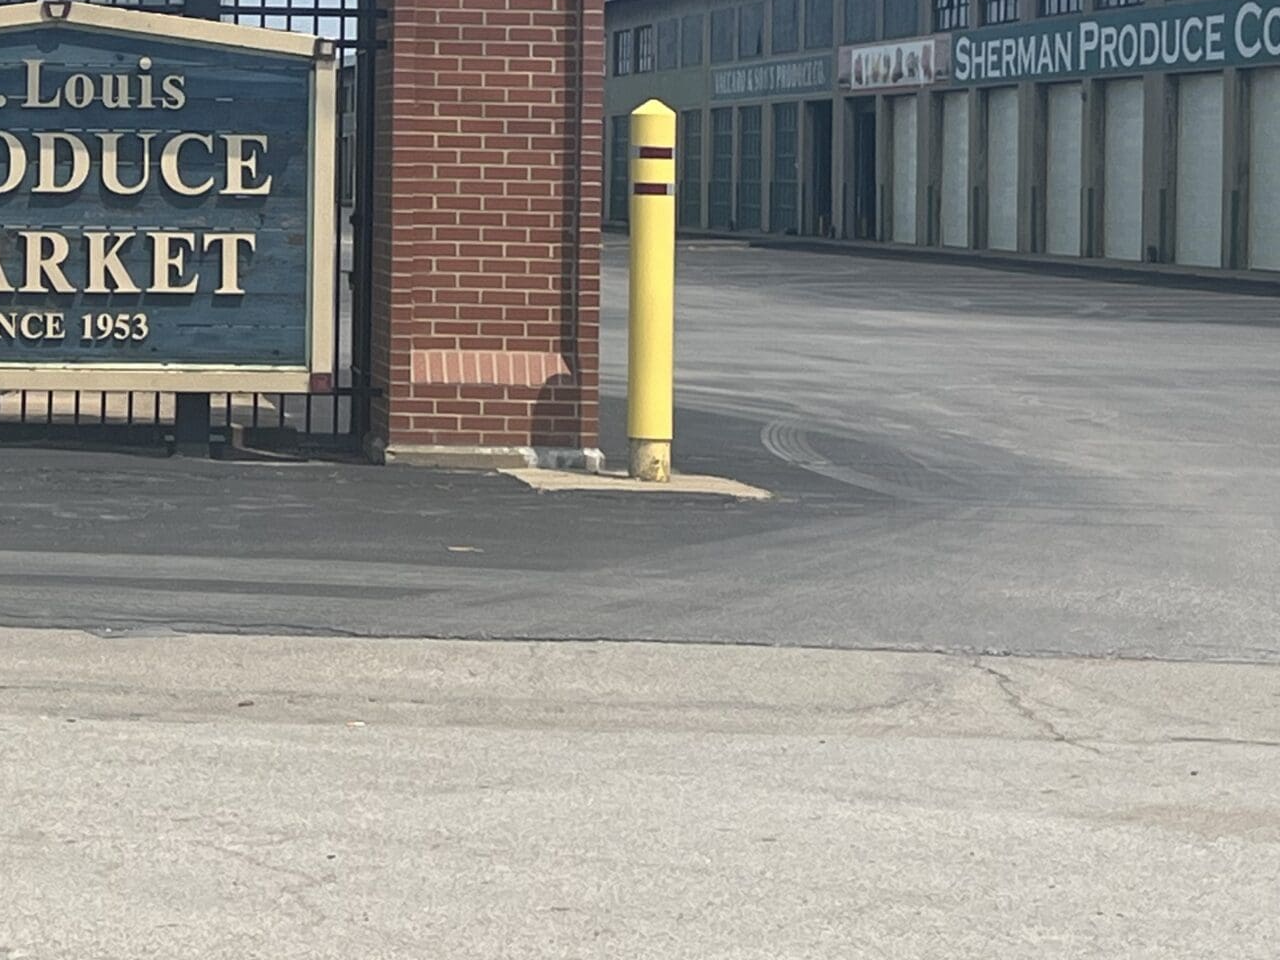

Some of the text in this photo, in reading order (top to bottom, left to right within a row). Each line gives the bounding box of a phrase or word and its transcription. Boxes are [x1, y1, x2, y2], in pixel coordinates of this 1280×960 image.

[954, 30, 1072, 82] SHERMAN
[1078, 13, 1225, 71] PRODUCE
[21, 56, 186, 110] Louis
[80, 311, 150, 341] 1953
